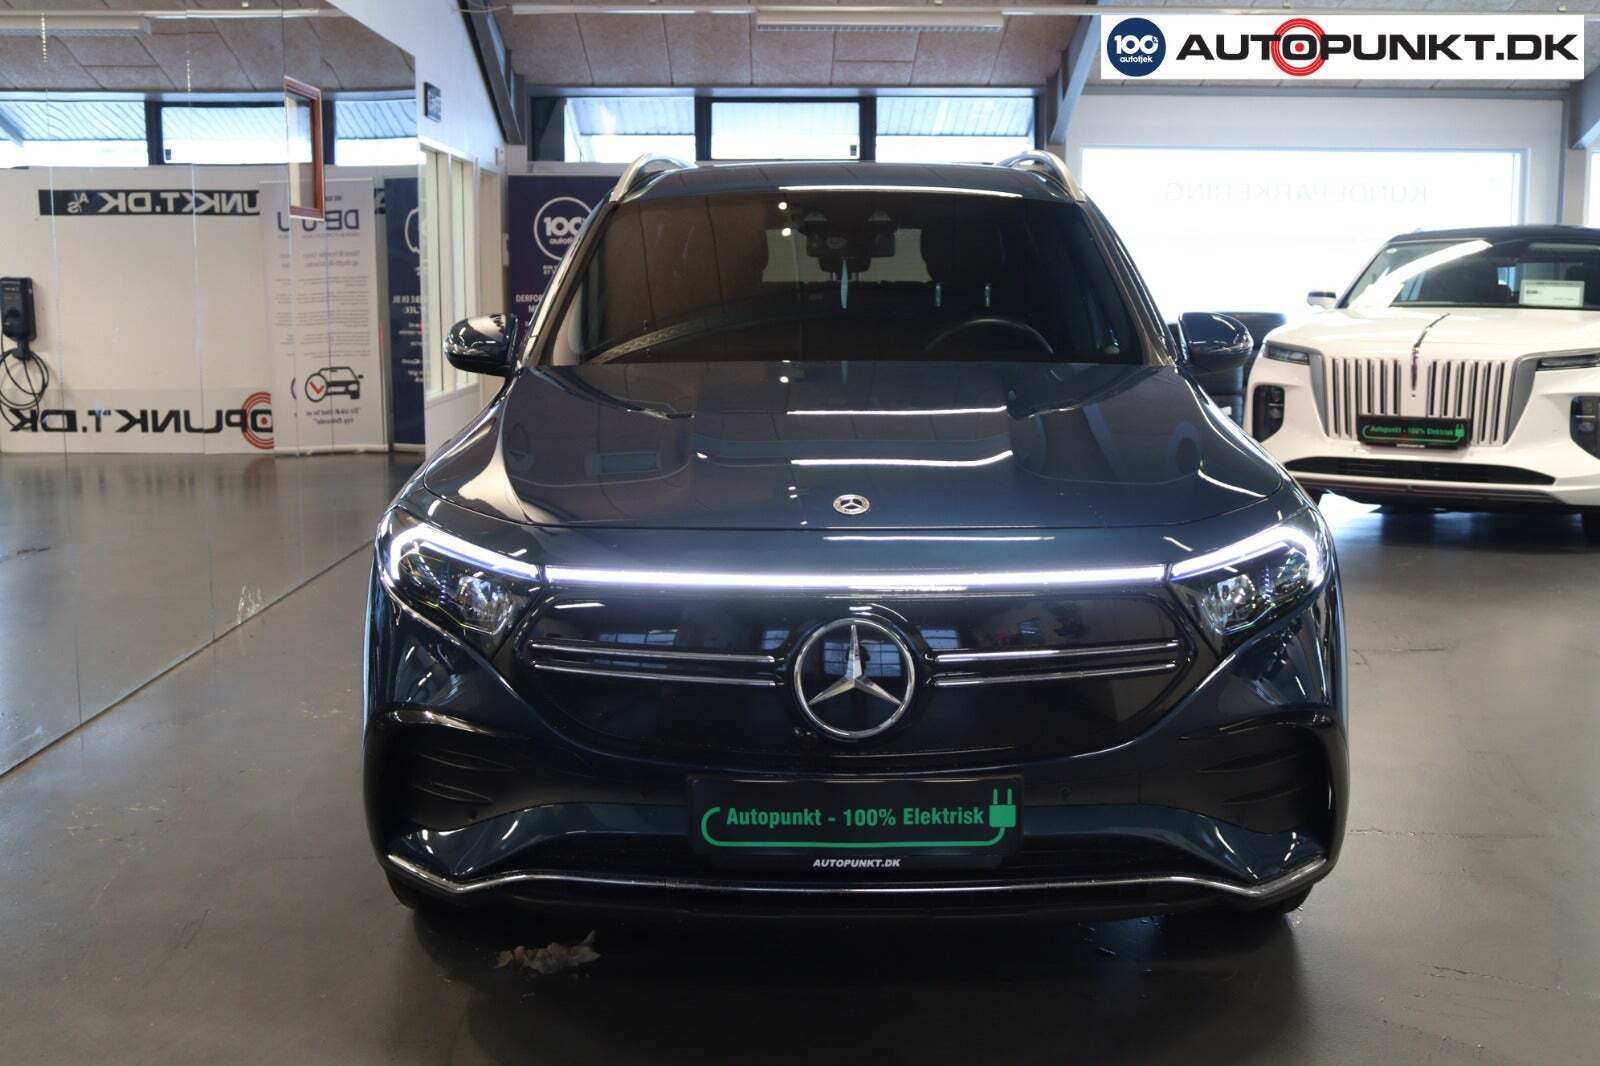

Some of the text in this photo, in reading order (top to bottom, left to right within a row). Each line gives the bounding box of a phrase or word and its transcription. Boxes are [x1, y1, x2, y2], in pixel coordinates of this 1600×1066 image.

[726, 807, 822, 829] Autopunkt
[843, 808, 897, 827] 100%
[903, 807, 984, 826] Elektrisk
[813, 858, 901, 868] AUTOPUNKT.DK
